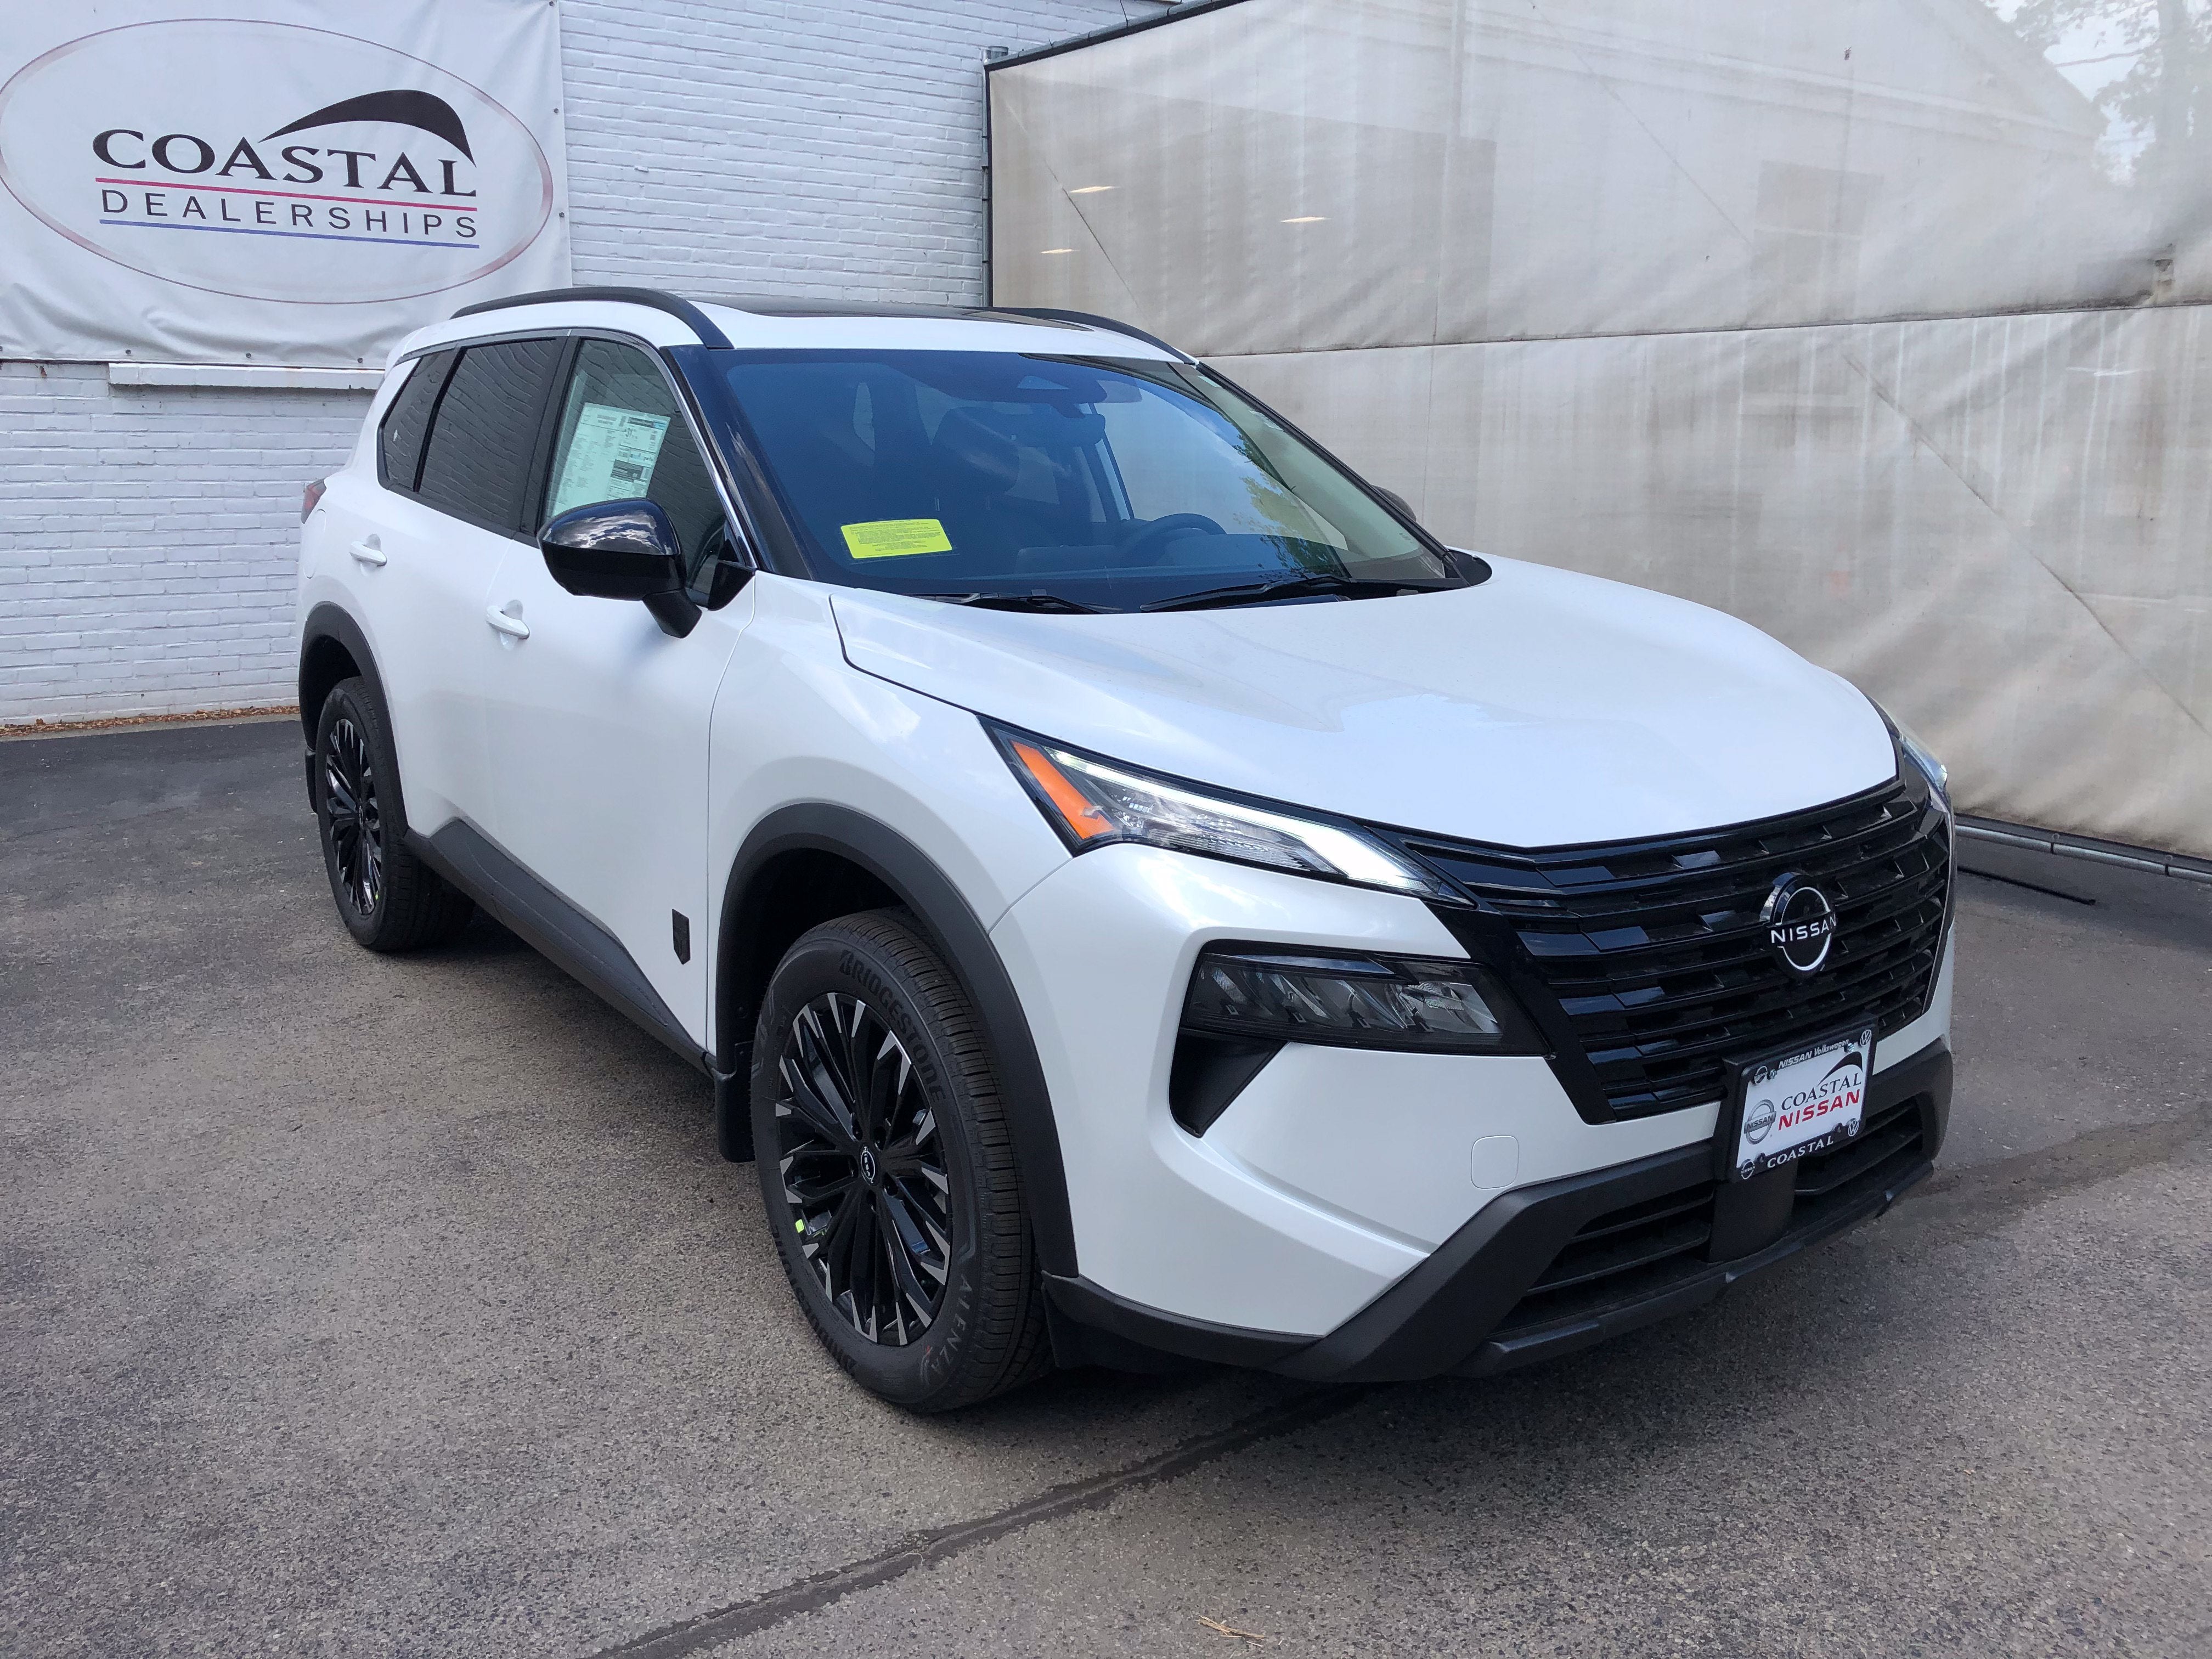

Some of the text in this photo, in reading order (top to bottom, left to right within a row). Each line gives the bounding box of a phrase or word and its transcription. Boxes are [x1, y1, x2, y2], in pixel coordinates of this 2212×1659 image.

[92, 128, 477, 198] COASTAL
[102, 189, 477, 238] DEALERSHIPS
[1770, 915, 1836, 943] NISSAN
[839, 950, 946, 1102] BRIDGESTONE
[1778, 1051, 1812, 1069] NISSAN
[1778, 1089, 1860, 1131] NISSAN
[1781, 1073, 1861, 1110] COASTAL
[1747, 1114, 1773, 1130] NISSAN
[1767, 1136, 1833, 1168] COASTAL
